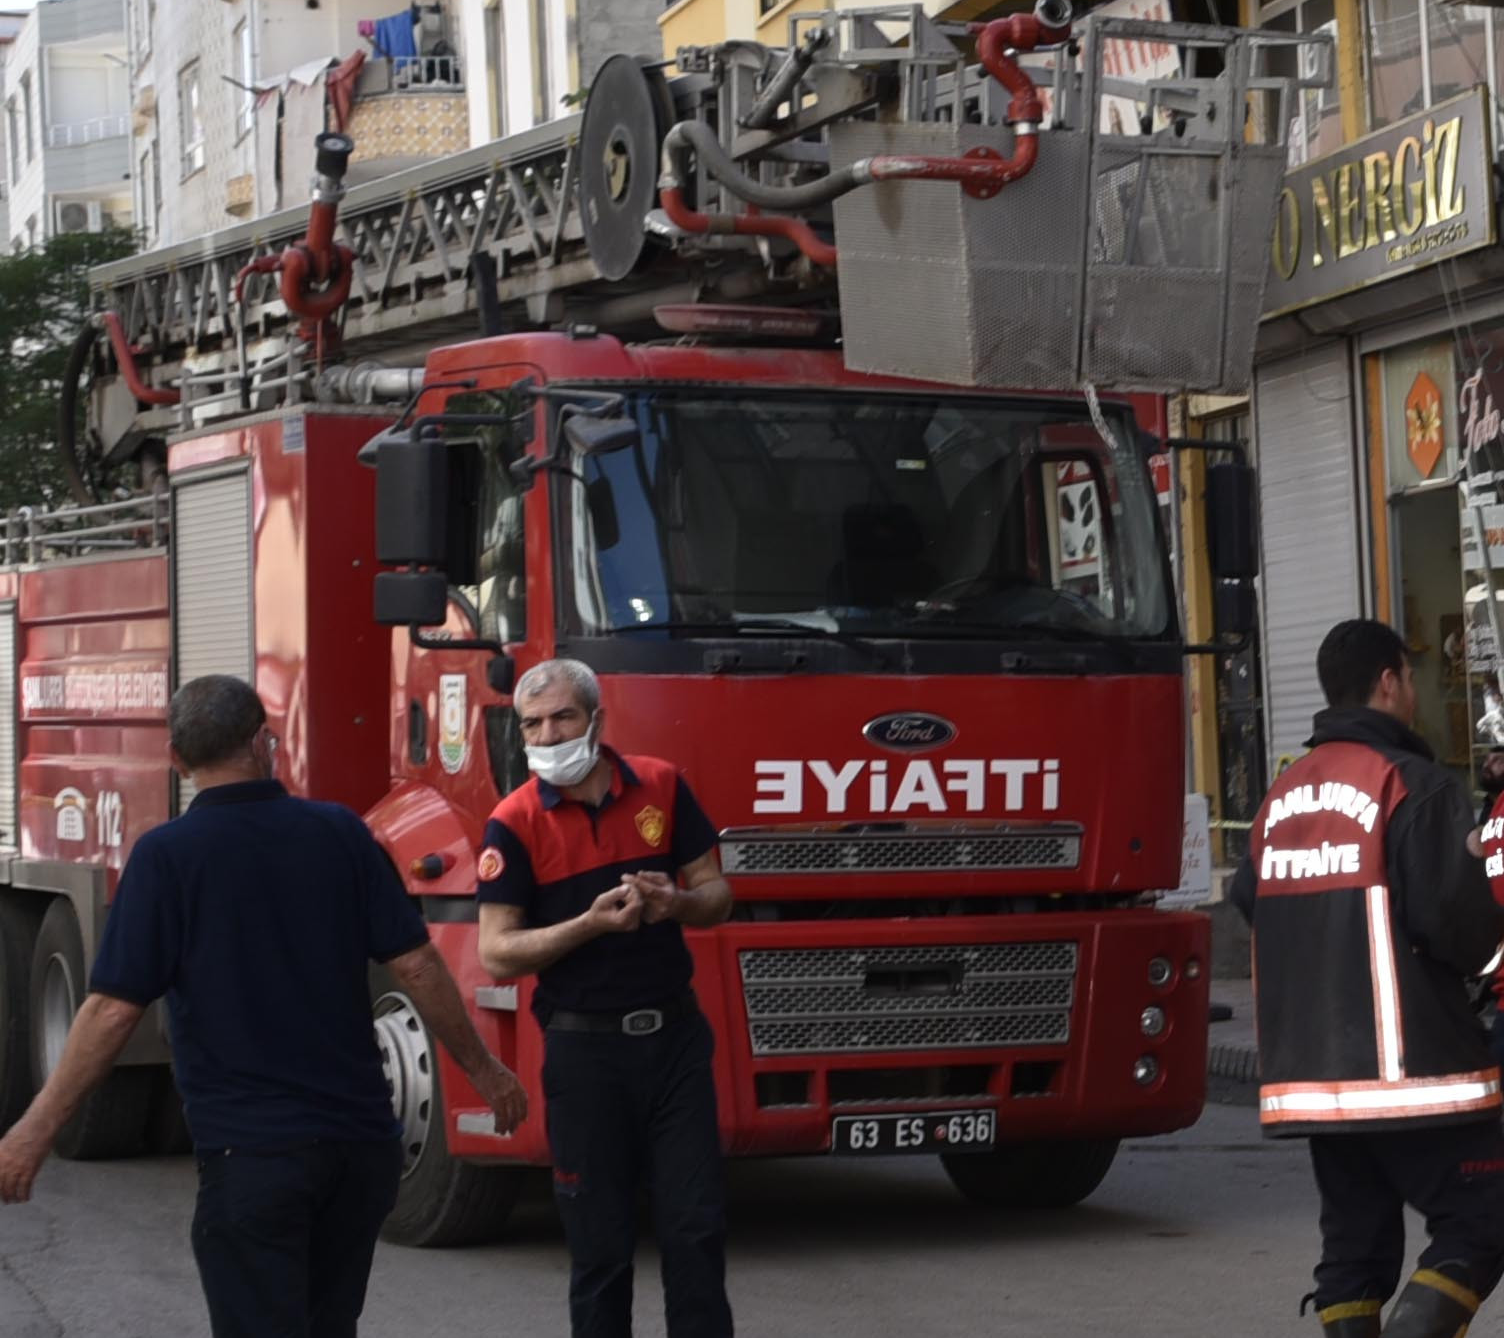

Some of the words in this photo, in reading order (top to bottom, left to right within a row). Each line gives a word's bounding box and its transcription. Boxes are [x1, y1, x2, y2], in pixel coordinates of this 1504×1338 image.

[1312, 116, 1464, 268] NERGİZ
[886, 720, 935, 742] Ford
[850, 1121, 879, 1149] 63
[896, 1118, 925, 1147] ES
[947, 1115, 991, 1143] 636
